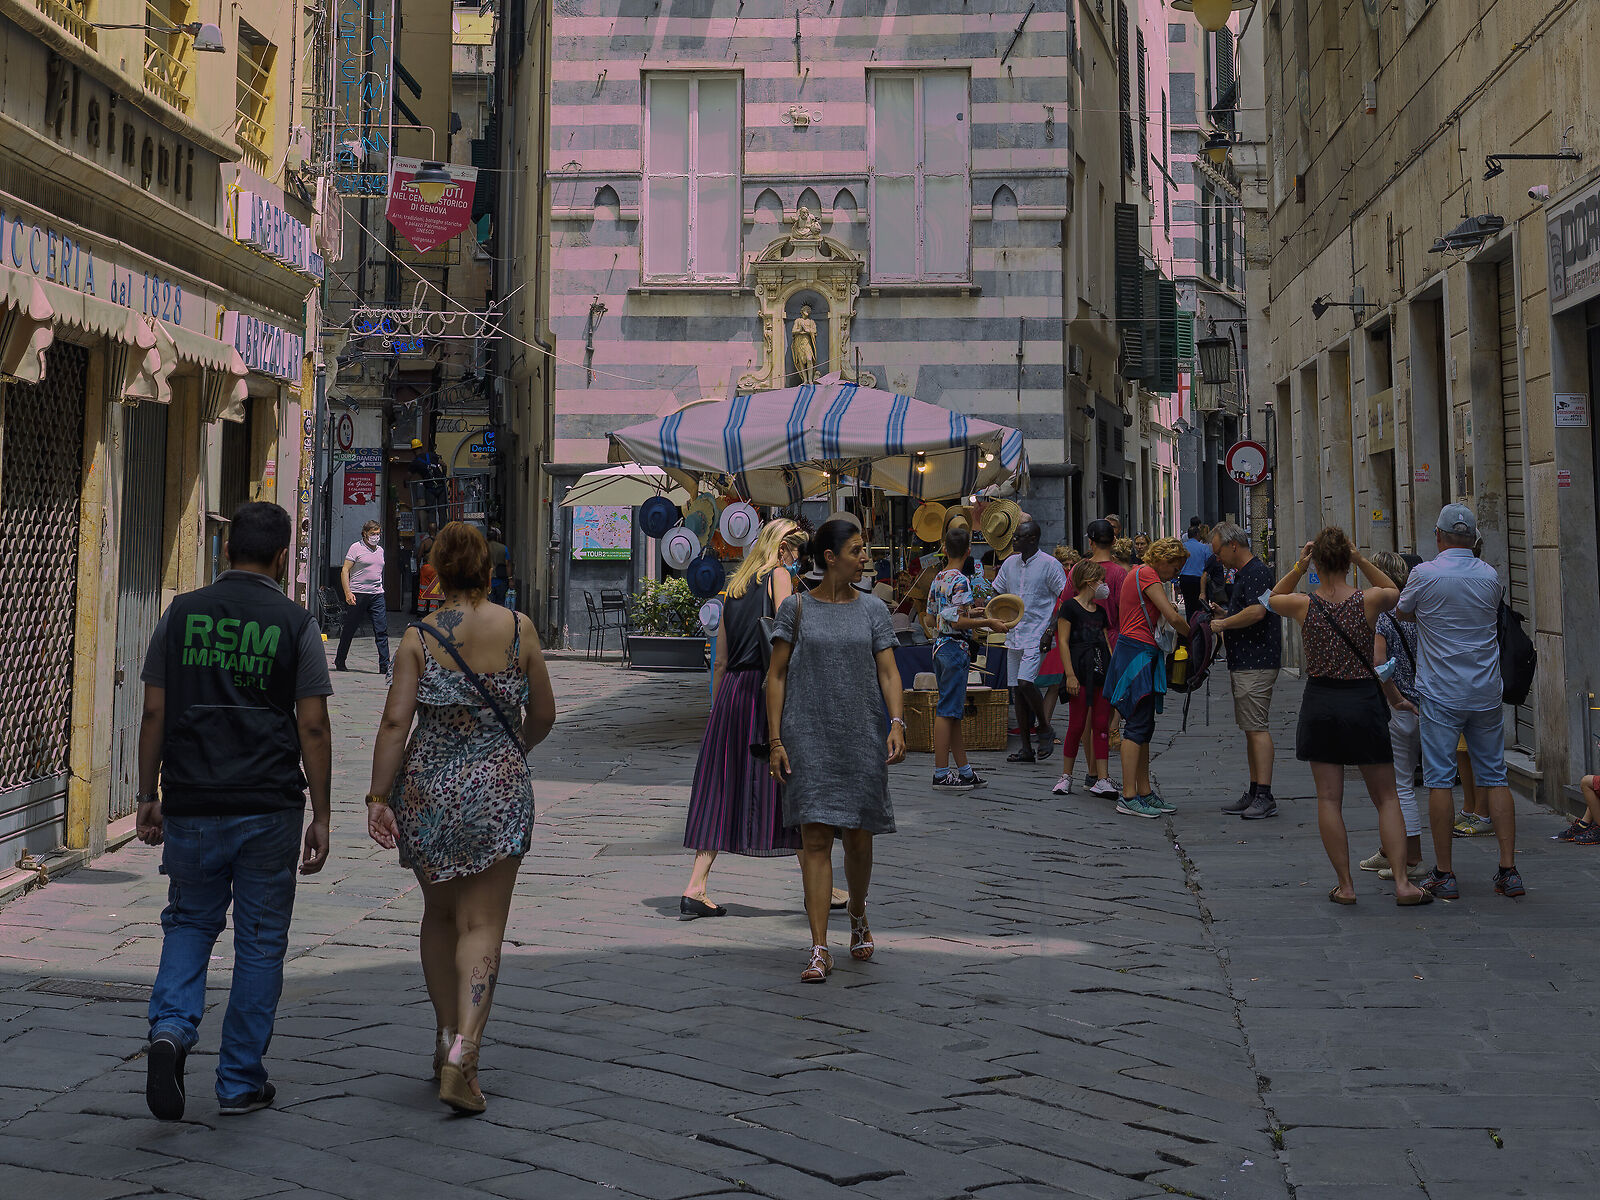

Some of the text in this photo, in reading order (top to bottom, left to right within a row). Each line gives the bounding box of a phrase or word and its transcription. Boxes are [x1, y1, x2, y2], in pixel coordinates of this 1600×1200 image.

[392, 191, 407, 200] NEL
[438, 198, 468, 209] STORICO
[410, 203, 447, 215] DI GENOVA
[1561, 190, 1600, 268] DOR
[111, 264, 131, 309] dal
[143, 270, 182, 325] 1828
[184, 614, 282, 657] RSM
[181, 647, 276, 676] IMPIANTI
